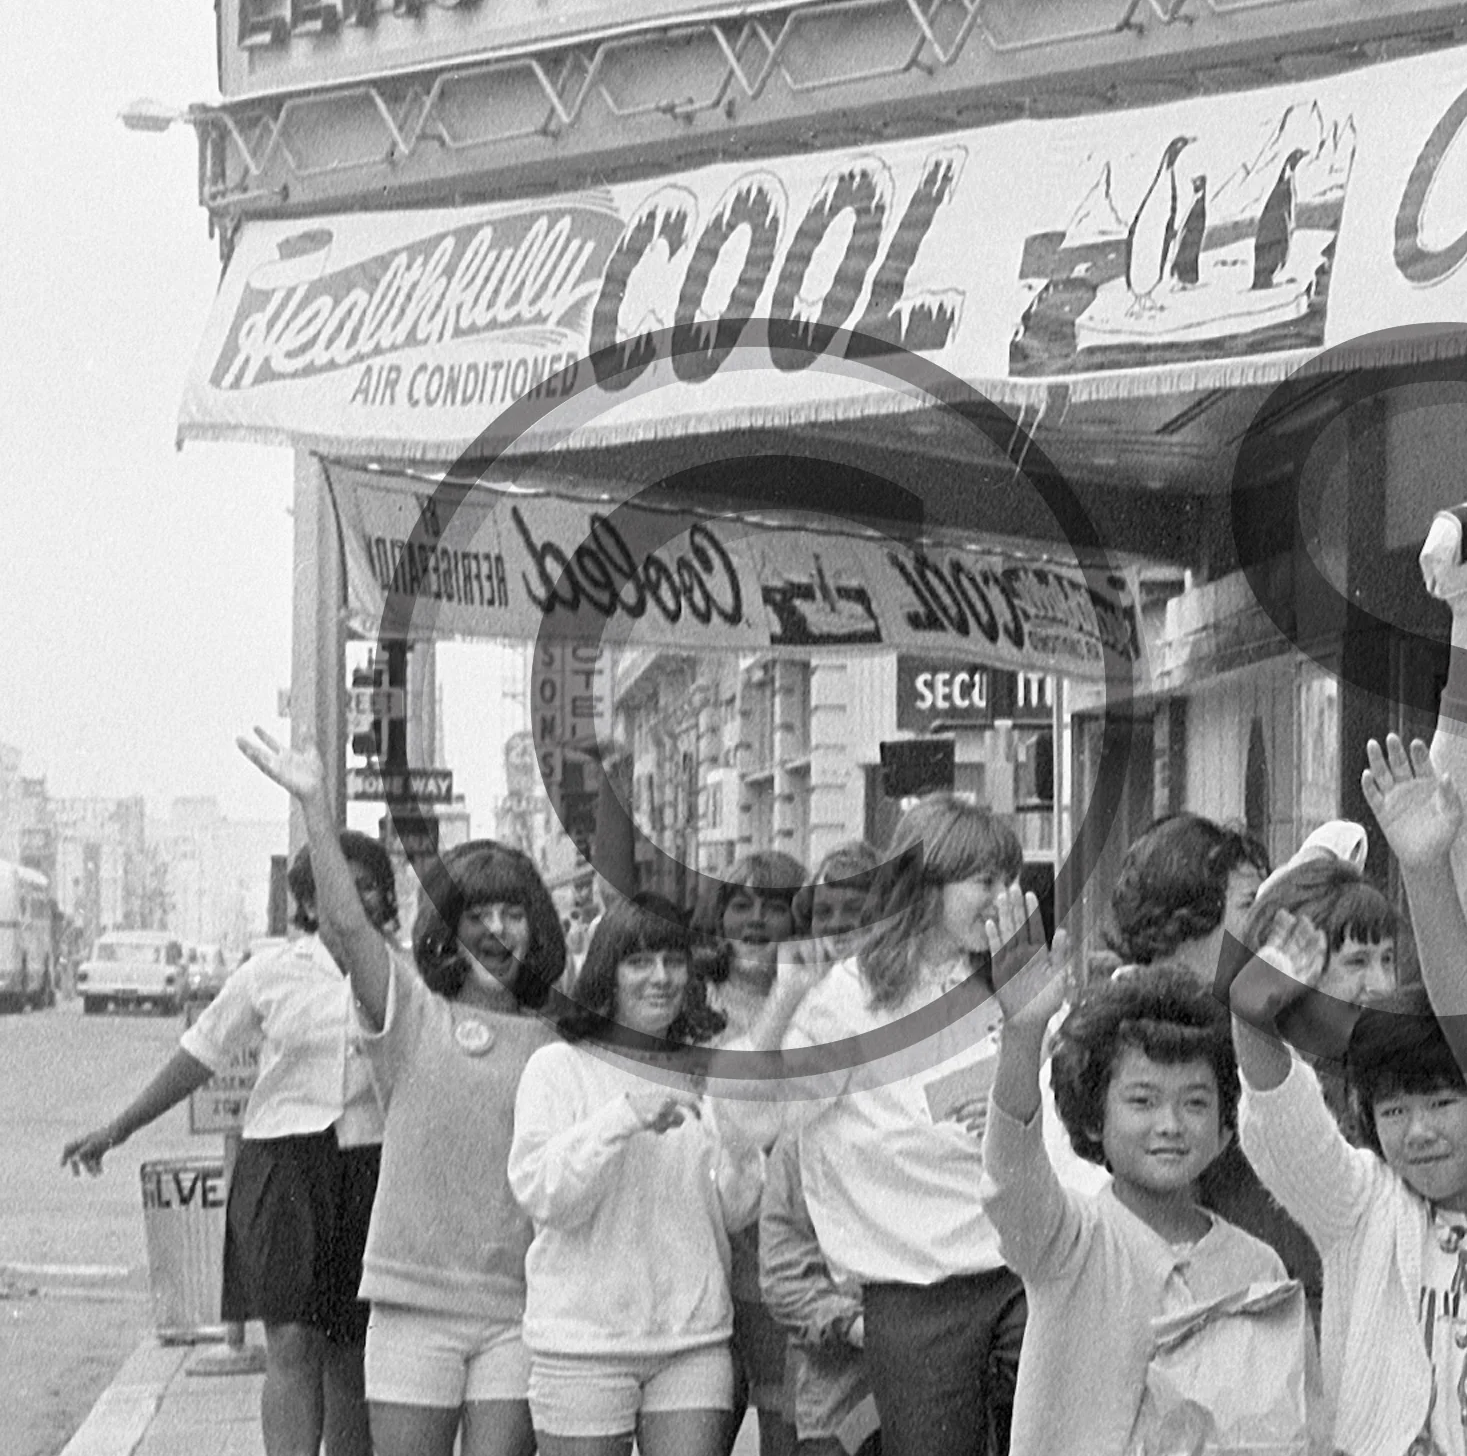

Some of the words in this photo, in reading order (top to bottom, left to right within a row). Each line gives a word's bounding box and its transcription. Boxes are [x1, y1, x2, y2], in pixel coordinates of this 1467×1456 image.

[218, 213, 602, 391] Healthfully
[589, 145, 967, 393] COOL
[349, 364, 398, 407] AIR
[406, 349, 579, 408] CONDITIONED
[914, 671, 1054, 710] SECUIT
[411, 774, 451, 794] WAY
